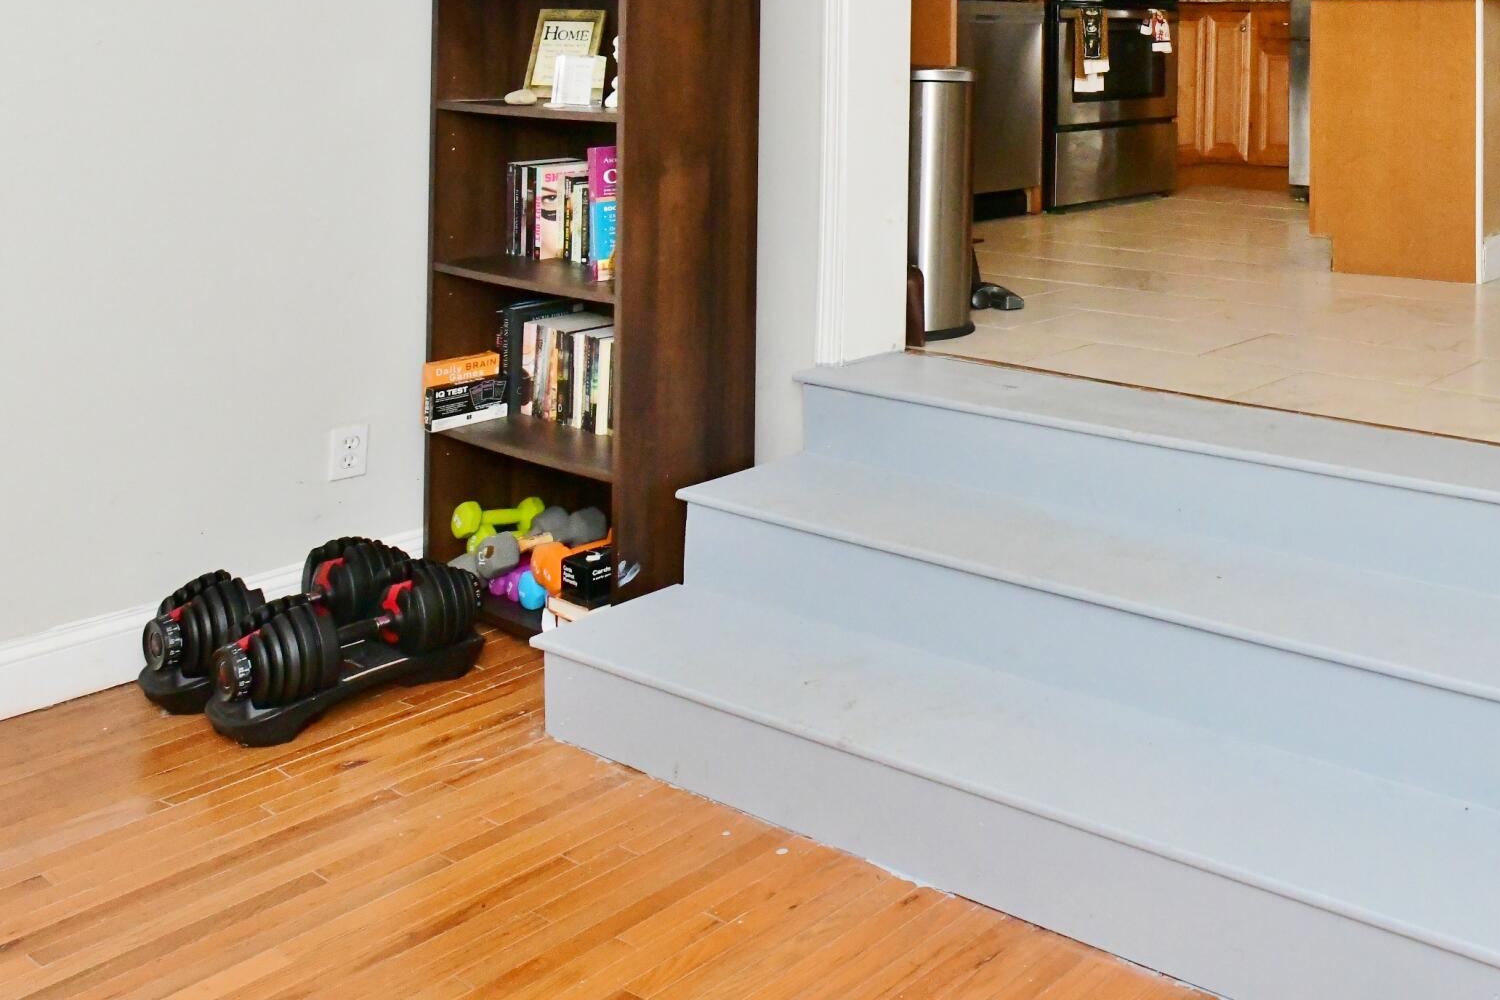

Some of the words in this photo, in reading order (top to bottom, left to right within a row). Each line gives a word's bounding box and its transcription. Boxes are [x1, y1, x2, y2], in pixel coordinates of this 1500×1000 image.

[435, 365, 462, 376] Daily
[465, 359, 497, 371] BRAIN
[449, 371, 484, 382] Games
[435, 391, 446, 399] IQ
[447, 386, 469, 396] TEST
